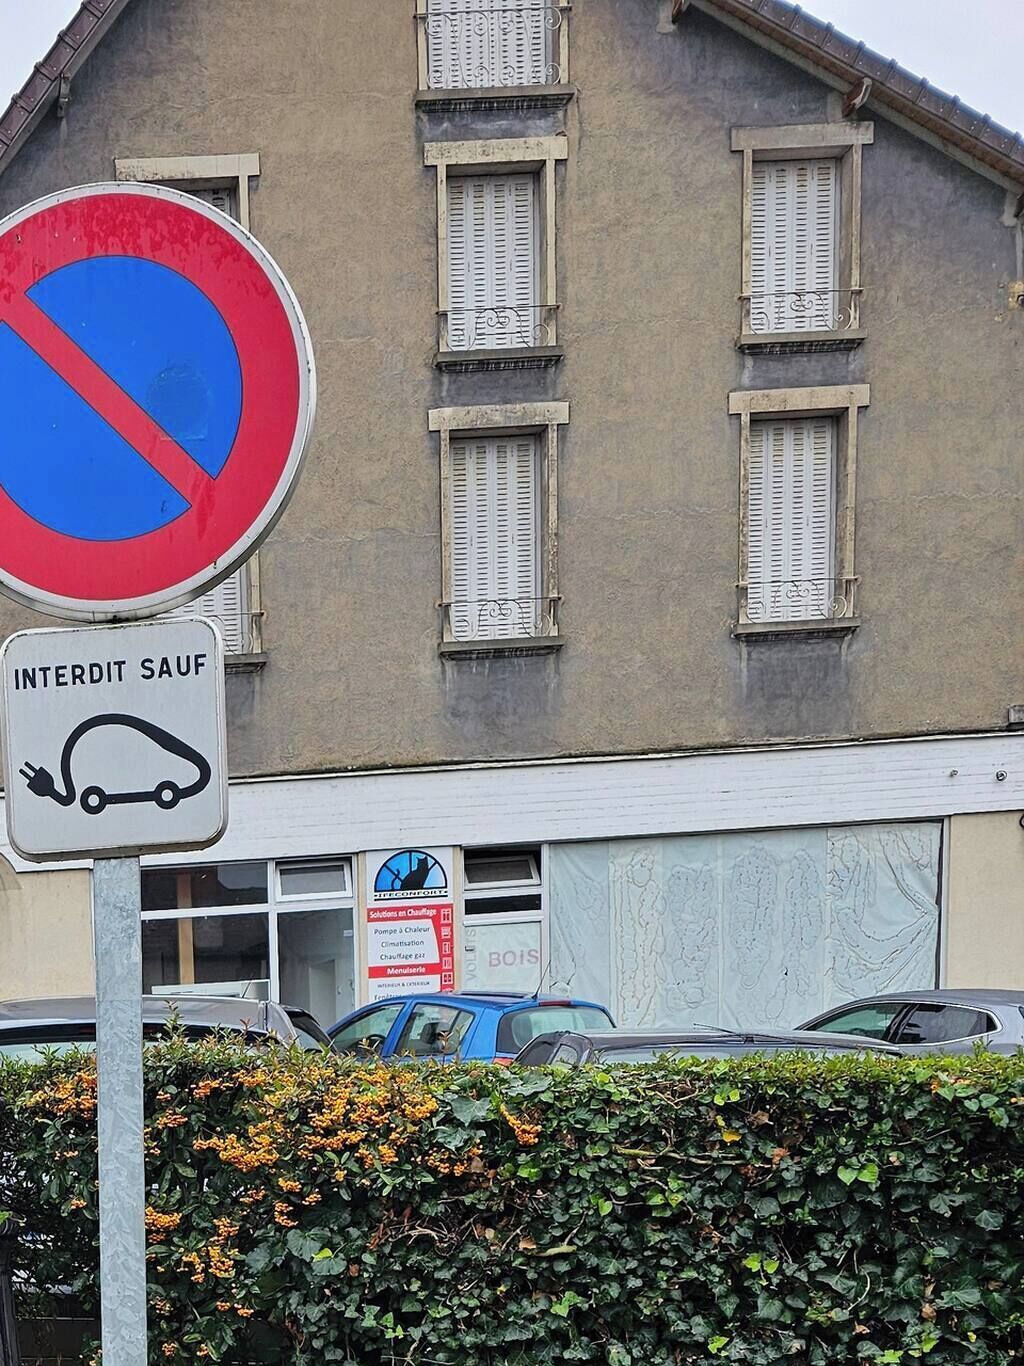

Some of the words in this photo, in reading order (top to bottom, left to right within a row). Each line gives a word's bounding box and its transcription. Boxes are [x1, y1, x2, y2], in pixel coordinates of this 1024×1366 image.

[14, 660, 126, 690] INTERDIT
[140, 653, 207, 680] SAUF
[369, 910, 397, 919] Solutions
[407, 907, 437, 917] Chauffage
[374, 928, 397, 936] Pompe
[381, 940, 424, 948] Climatisation
[380, 953, 413, 961] Chauffage
[387, 966, 426, 975] Menuiserie
